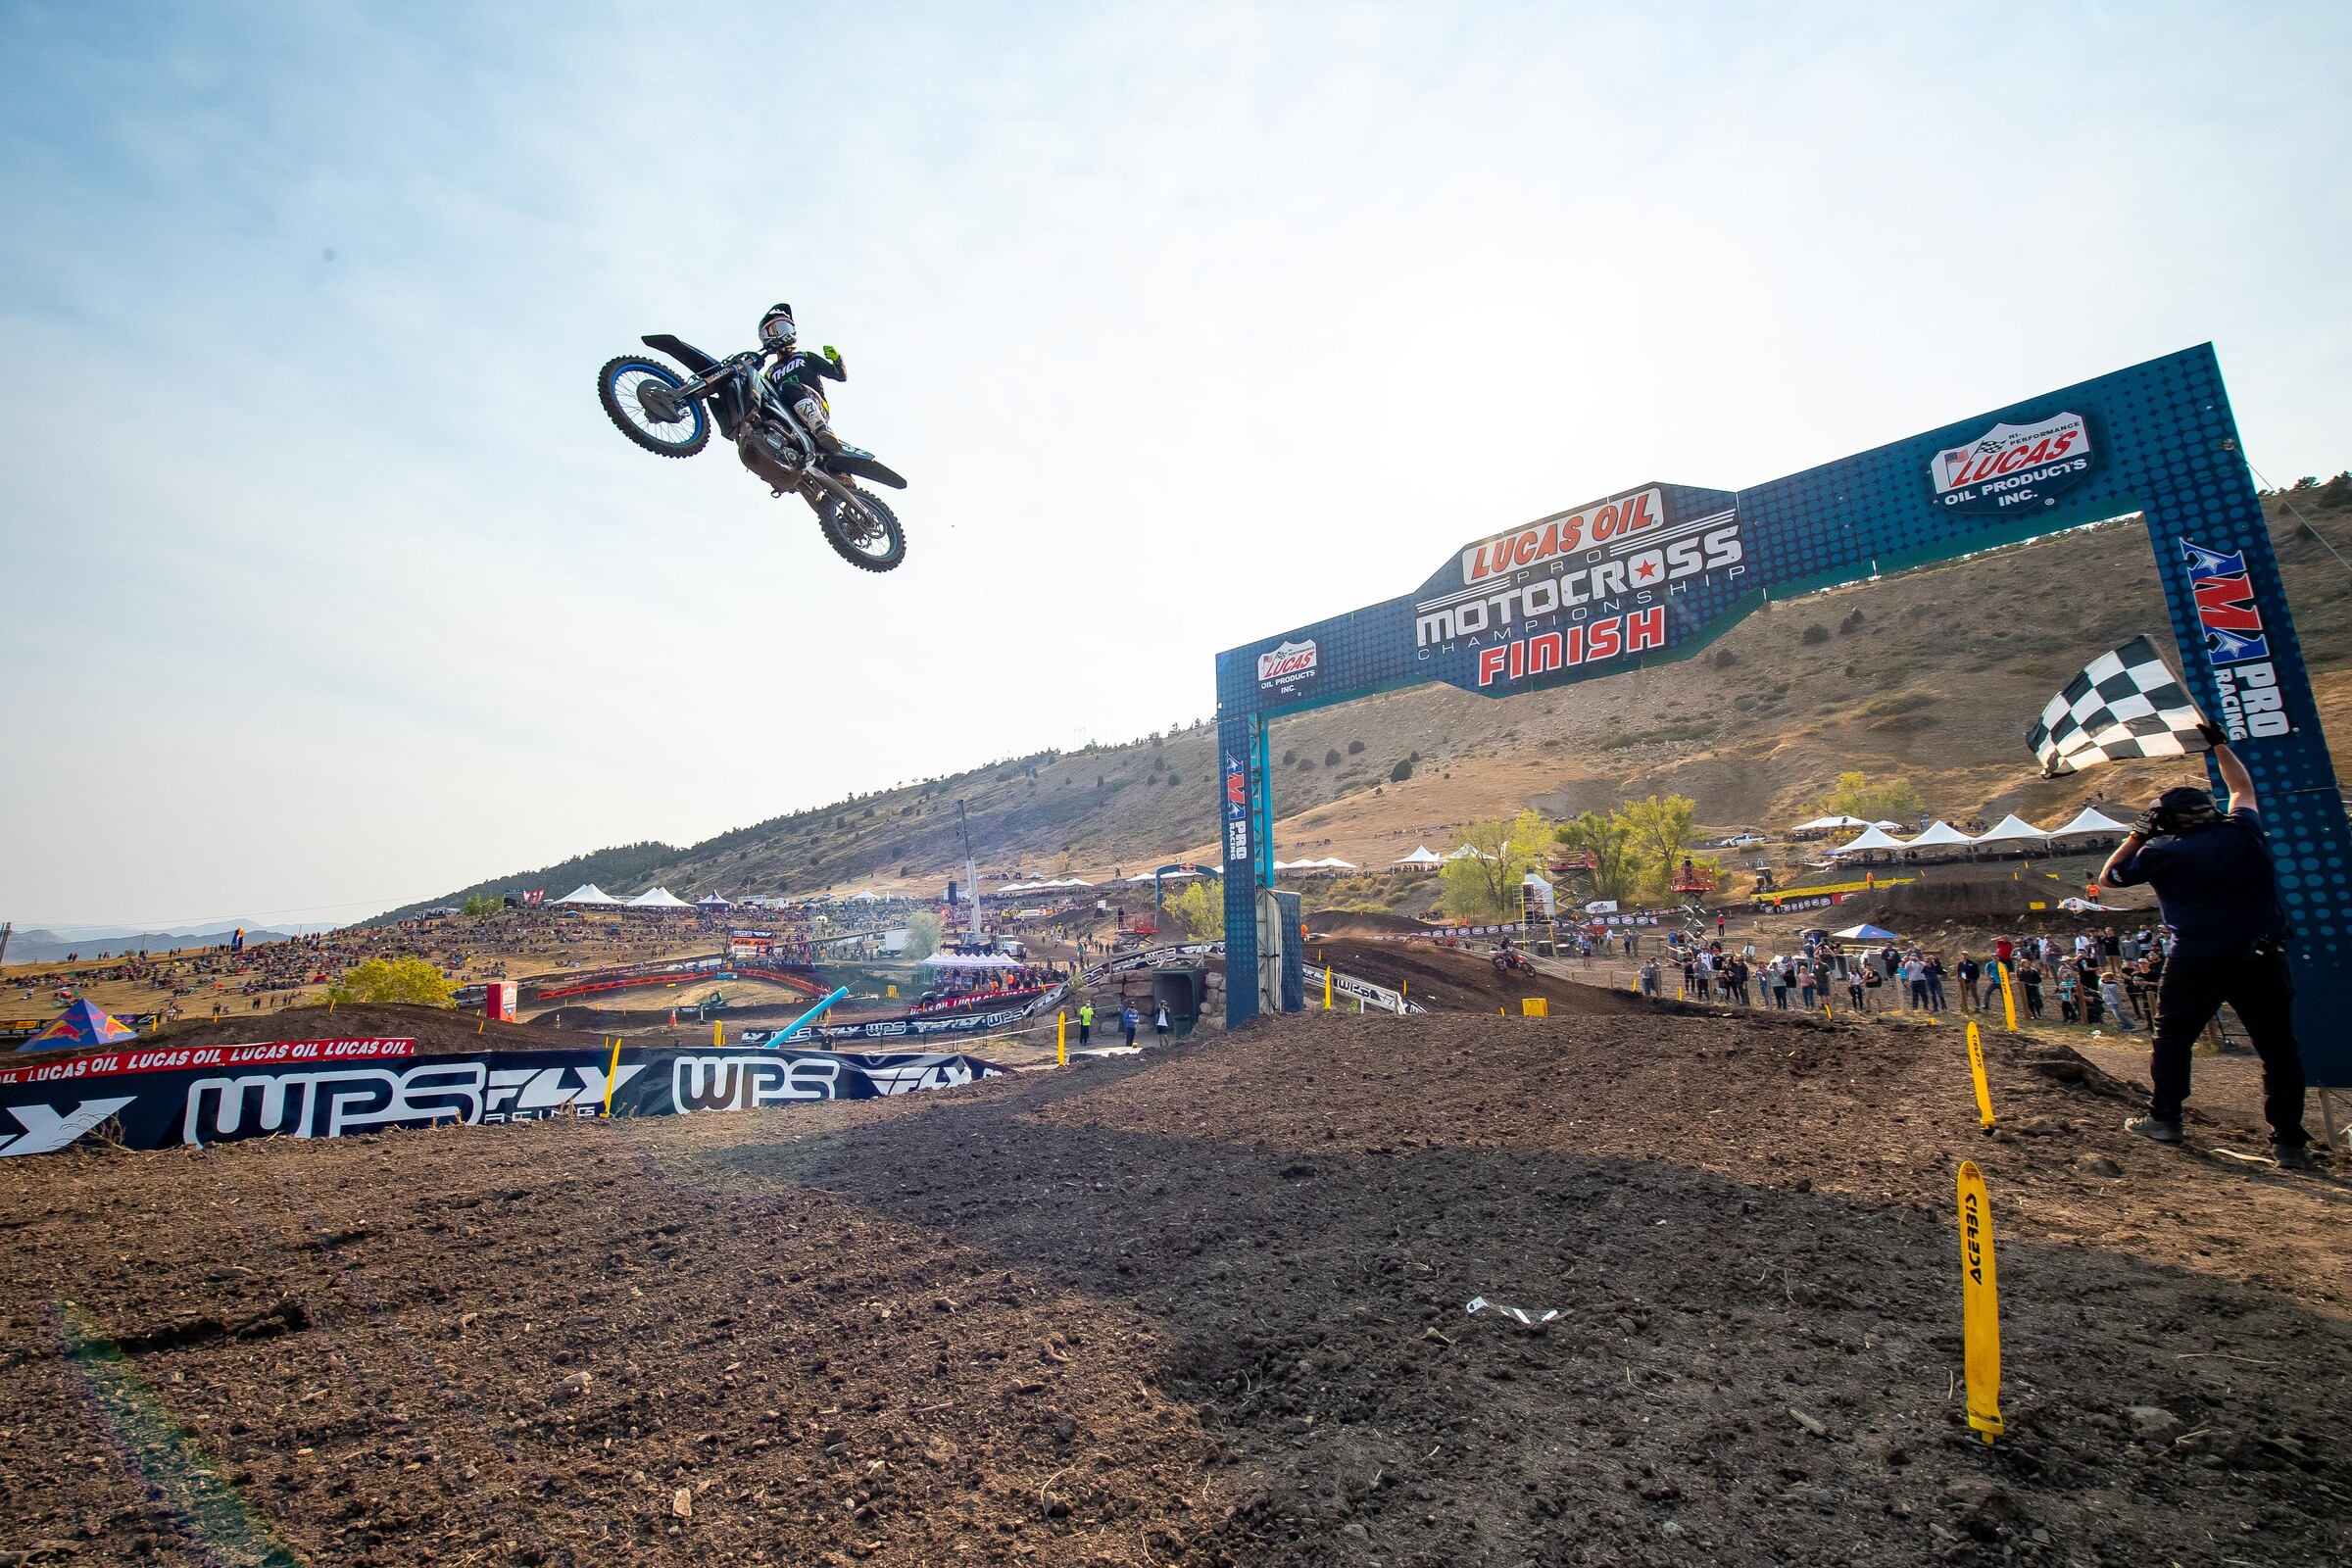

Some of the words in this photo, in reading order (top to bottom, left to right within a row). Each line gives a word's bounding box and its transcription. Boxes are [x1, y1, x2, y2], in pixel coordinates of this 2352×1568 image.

[772, 359, 806, 383] THOR
[1950, 430, 2078, 487] LUCAS
[2010, 421, 2081, 446] PERFORMANCE
[1944, 490, 1977, 506] OIL
[1982, 458, 2087, 496] PRODUCTS
[1998, 489, 2038, 507] INC.
[1471, 515, 1584, 580] LUCAS
[1592, 493, 1654, 541] OIL
[1416, 525, 1742, 647] MOTOCROSS
[1517, 550, 1601, 583] PRO
[1418, 565, 1746, 661] CHAMPIONSHIP
[2180, 537, 2271, 665] AMA
[2234, 662, 2290, 738] PRO
[1264, 651, 1314, 678] LUCAS
[1479, 605, 1665, 687] FINISH
[1275, 670, 1315, 686] PRODUCTS
[1281, 685, 1296, 694] INC.
[2214, 668, 2248, 741] RACING
[1227, 750, 1246, 820] AMA
[1236, 820, 1247, 859] PRO
[27, 1060, 87, 1082] LUCAS
[91, 1056, 119, 1072] OIL
[127, 1052, 188, 1069] LUCAS
[192, 1050, 221, 1064] OIL
[230, 1045, 289, 1061] LUCAS
[292, 1043, 319, 1056] OIL
[324, 1041, 379, 1055] LUCAS
[381, 1041, 406, 1054] OIL
[1972, 1034, 1983, 1069] ACERBIS
[182, 1063, 486, 1151] WPS
[672, 1055, 840, 1115] WPS
[1965, 1193, 1982, 1286] ACERBIS
